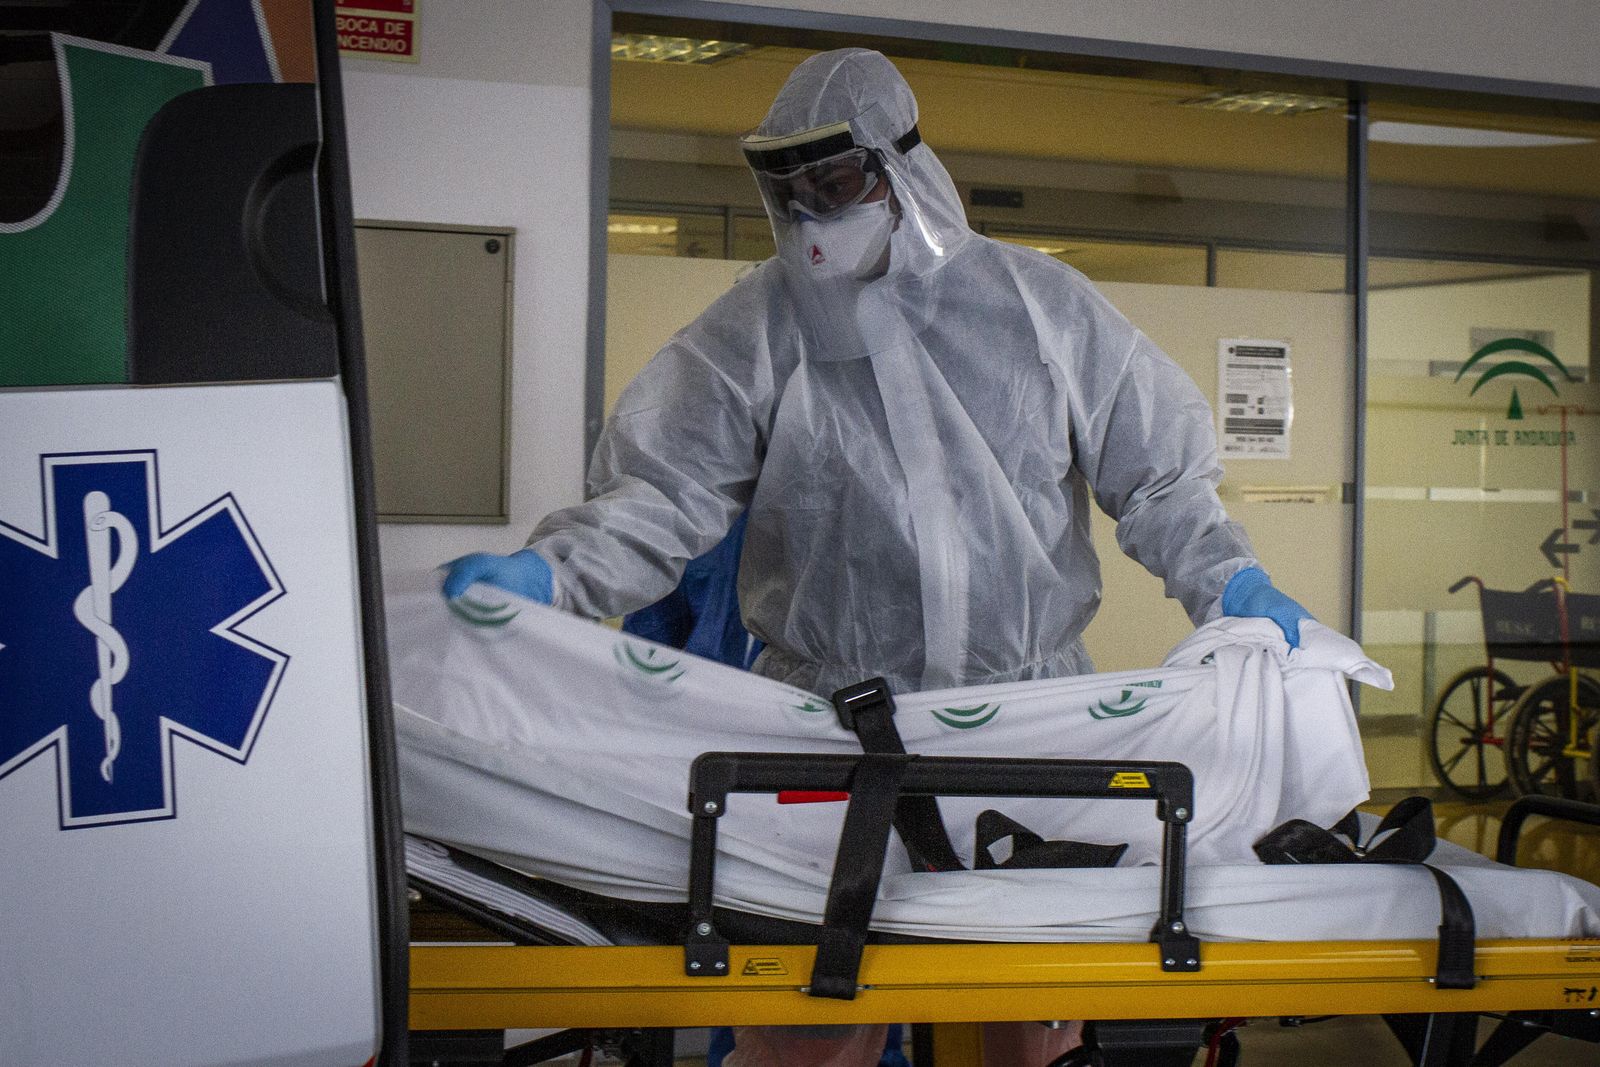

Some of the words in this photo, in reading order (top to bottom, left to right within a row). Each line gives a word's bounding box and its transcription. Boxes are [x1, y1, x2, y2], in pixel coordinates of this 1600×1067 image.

[336, 17, 378, 33] BOCA
[384, 22, 406, 36] DE
[337, 34, 407, 52] NCENDIO
